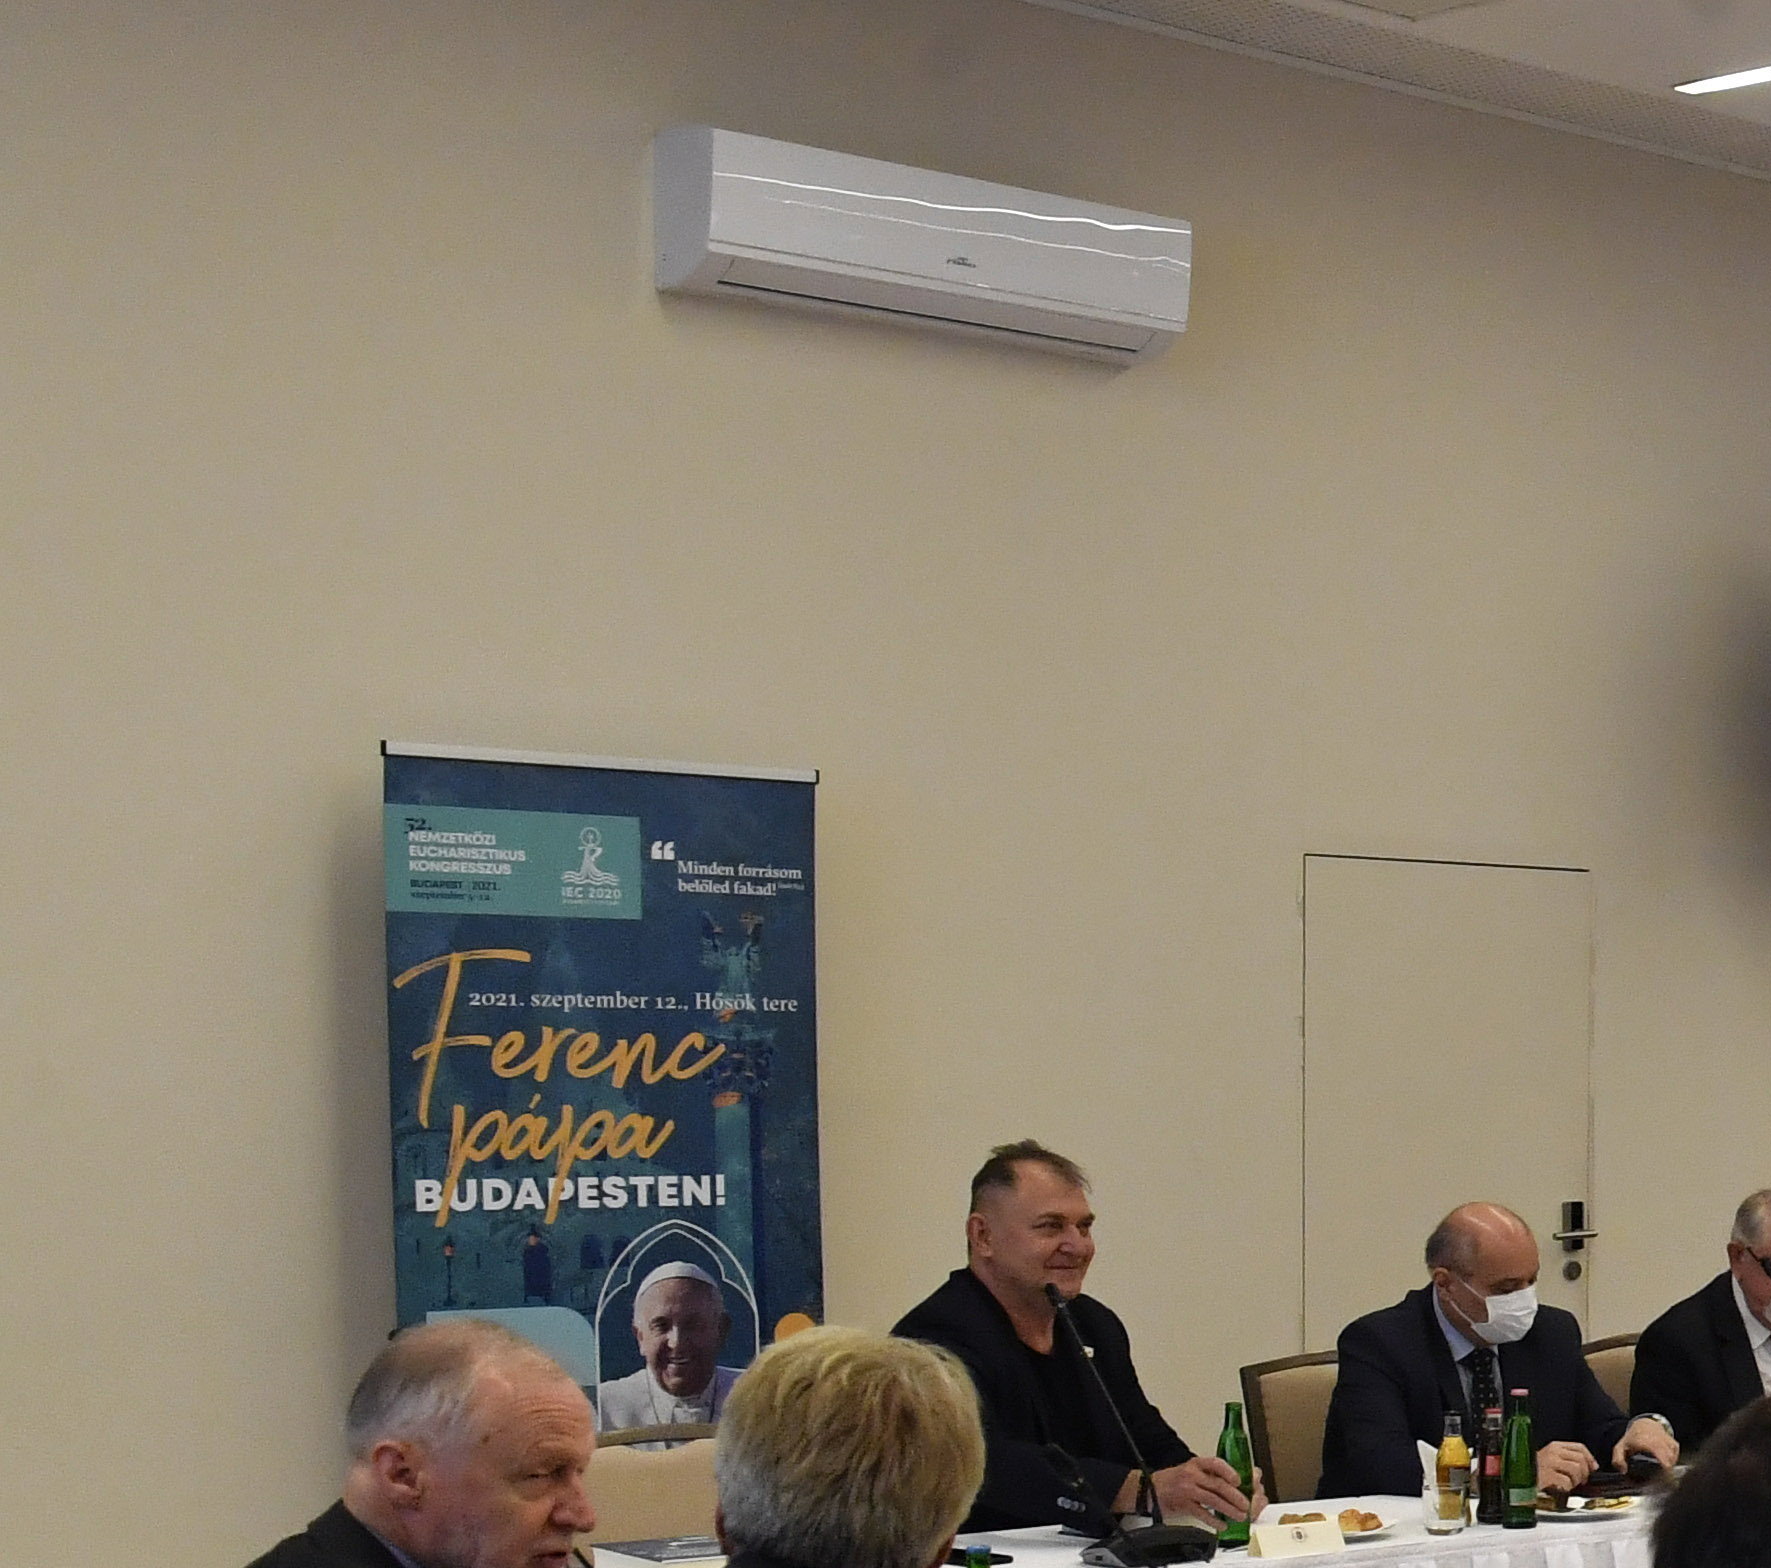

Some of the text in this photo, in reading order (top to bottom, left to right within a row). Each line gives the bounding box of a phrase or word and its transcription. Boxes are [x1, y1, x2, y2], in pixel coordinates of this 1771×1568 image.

[408, 830, 496, 845] NEMZETKÖZI
[408, 845, 526, 861] EUCHARISZTIKUS
[408, 860, 512, 875] KONGRESSZUS
[677, 860, 802, 879] Minden forrásom
[562, 886, 622, 899] IEC 2020
[677, 878, 730, 894] belőled
[733, 881, 777, 896] fakad!
[468, 992, 524, 1008] 2021.
[530, 992, 648, 1012] szeptember
[695, 991, 756, 1012] Hősök
[763, 995, 798, 1012] tere
[393, 948, 726, 1129] Ferenc
[435, 1093, 676, 1228] pápa
[414, 1175, 726, 1212] BUDAPESTEN!
